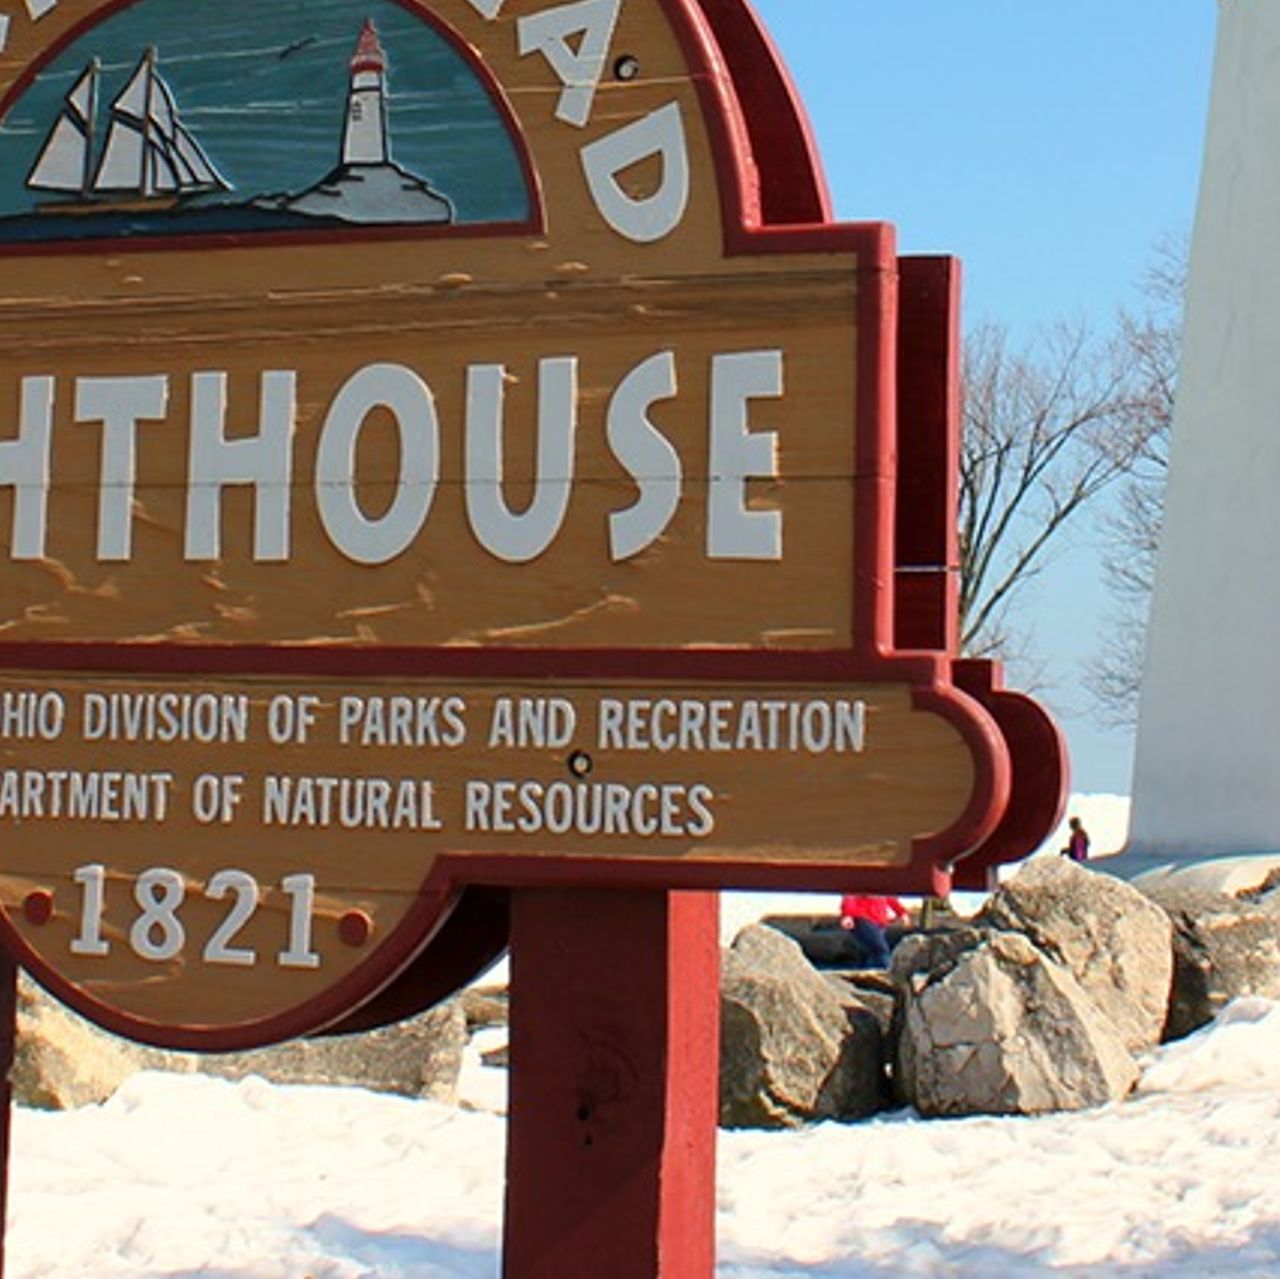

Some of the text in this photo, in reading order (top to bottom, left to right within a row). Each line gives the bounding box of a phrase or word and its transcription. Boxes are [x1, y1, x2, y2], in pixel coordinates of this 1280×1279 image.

[84, 692, 249, 743] DIVISION
[267, 694, 320, 744] OF
[339, 696, 467, 747] PARKS
[488, 697, 577, 748] AND
[598, 698, 867, 753] RECREATION
[193, 773, 244, 822] OF
[263, 775, 443, 829] NATURAL
[465, 780, 714, 836] RESOURCES
[70, 863, 320, 967] 1821
